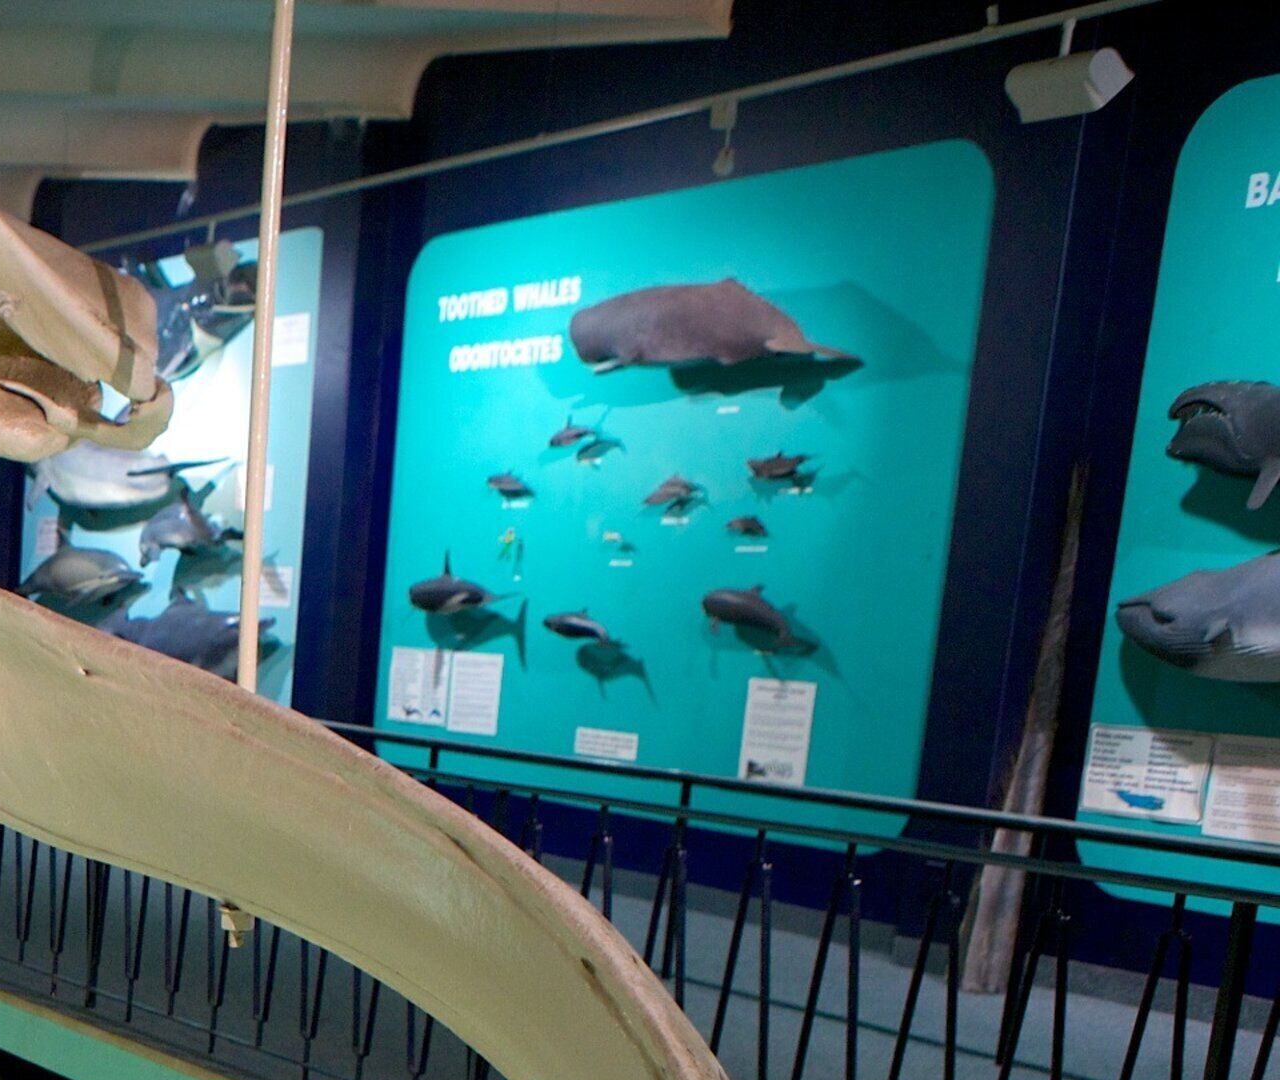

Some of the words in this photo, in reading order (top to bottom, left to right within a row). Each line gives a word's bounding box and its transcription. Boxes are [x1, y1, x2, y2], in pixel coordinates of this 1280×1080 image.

[438, 288, 508, 322] TOOTHED
[513, 276, 581, 313] WHALES
[449, 335, 563, 373] ODONTOCETES
